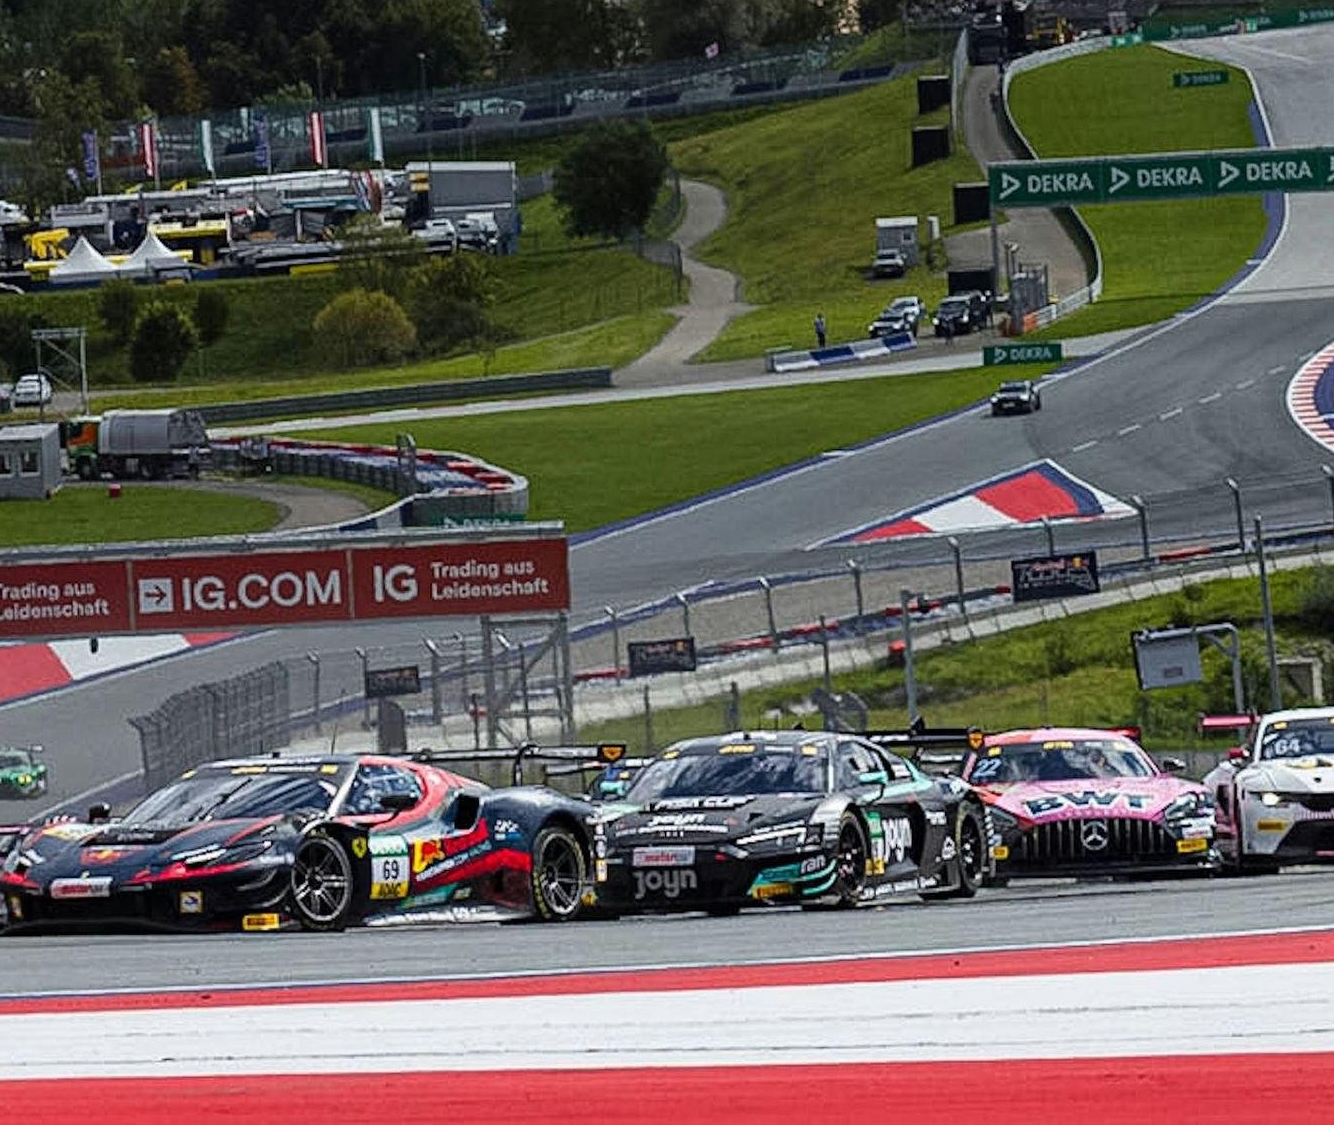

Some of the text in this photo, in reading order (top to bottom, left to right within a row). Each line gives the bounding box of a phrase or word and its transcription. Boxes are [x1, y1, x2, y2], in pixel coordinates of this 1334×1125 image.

[1137, 167, 1203, 187] DEKRA
[1247, 161, 1313, 182] DEKRA
[1028, 173, 1094, 193] DEKRA
[430, 560, 536, 580] Trading aus
[63, 583, 96, 598] aus
[182, 569, 342, 611] IG.COM
[374, 564, 418, 602] IG
[431, 576, 550, 600] Leidenschaft
[1274, 738, 1301, 755] 64
[973, 759, 1002, 776] 22
[1023, 790, 1154, 818] BWT
[383, 859, 400, 880] 69
[801, 854, 827, 874] ran
[631, 869, 698, 900] joyn
